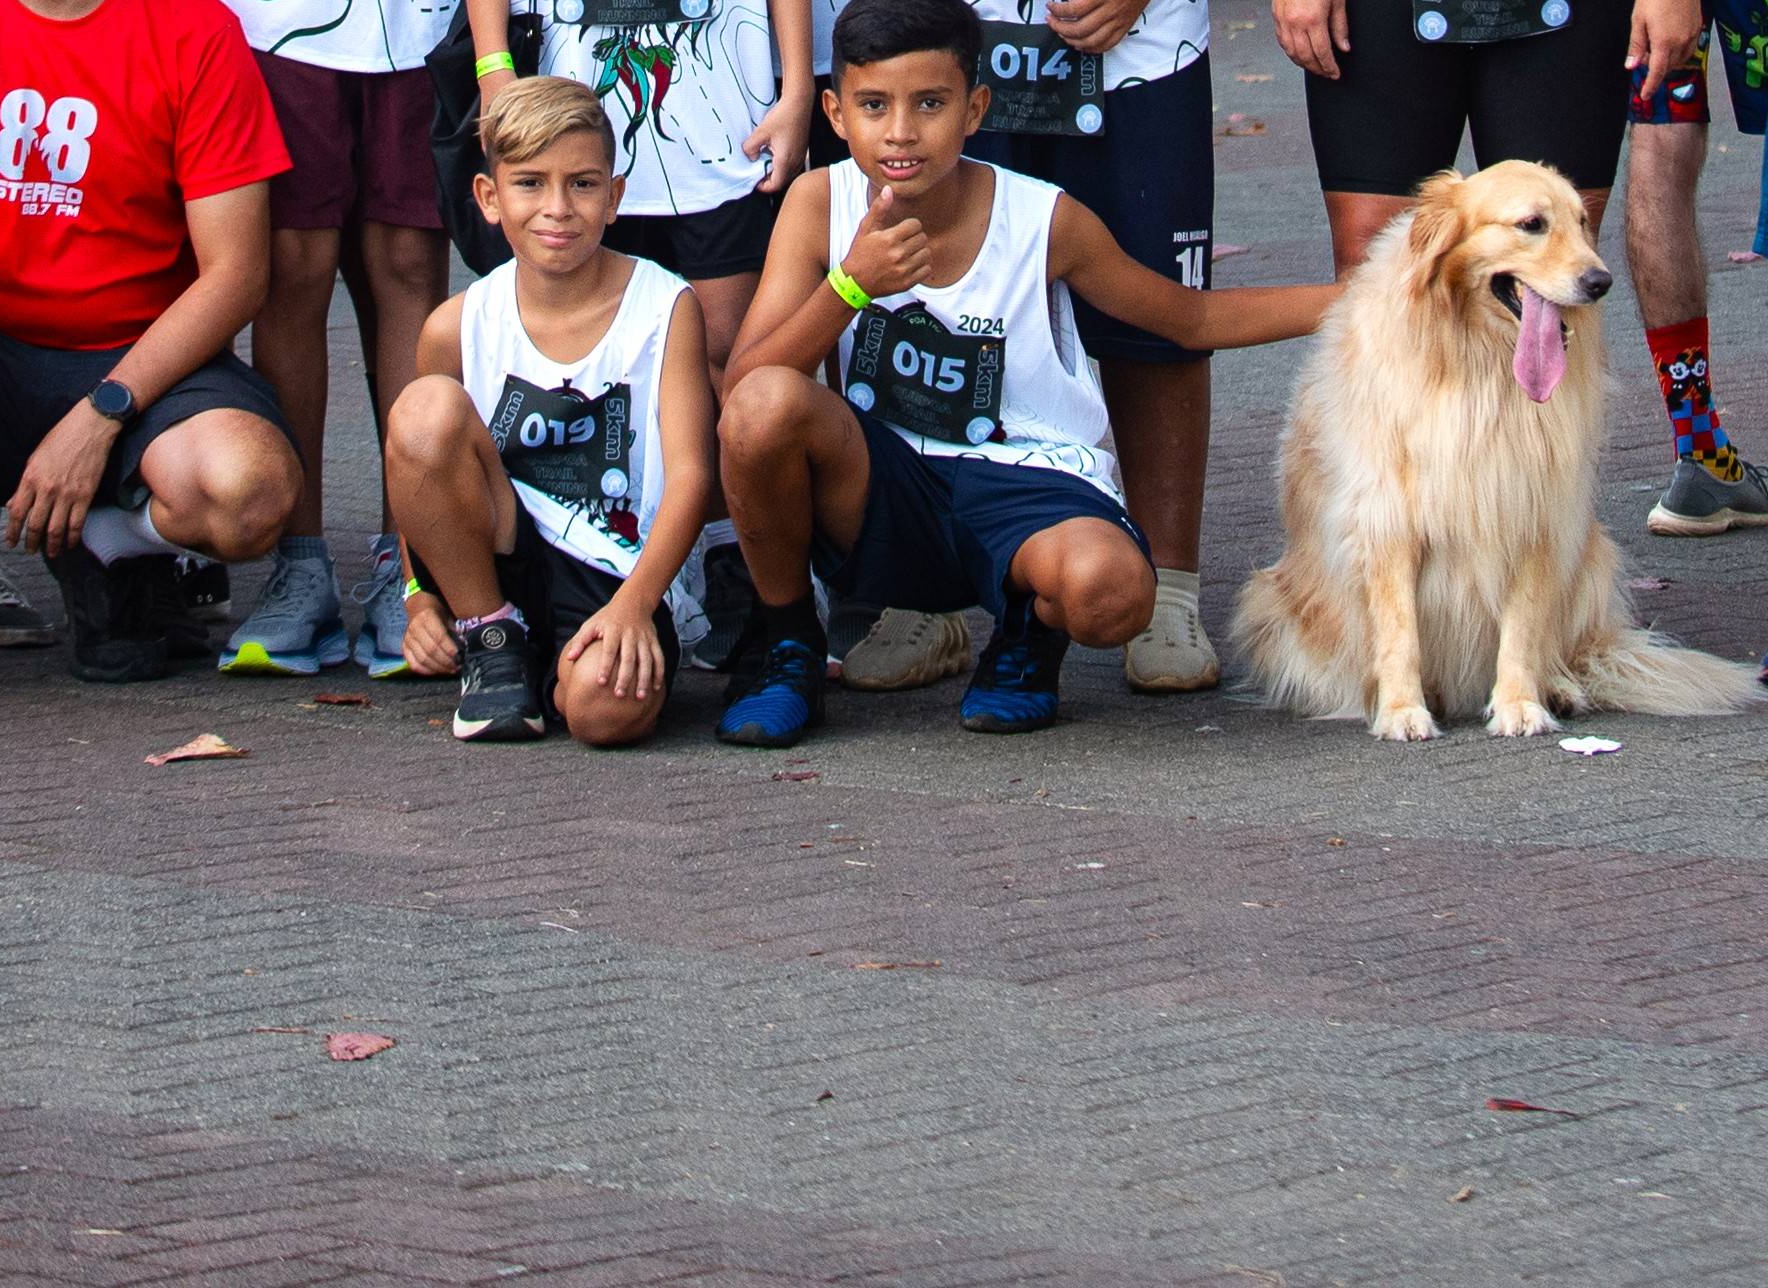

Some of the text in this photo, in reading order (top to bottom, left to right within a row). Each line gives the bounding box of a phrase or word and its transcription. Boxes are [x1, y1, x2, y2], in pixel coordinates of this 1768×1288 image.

[990, 42, 1073, 82] 014
[1079, 52, 1097, 97] km
[54, 204, 81, 218] FM
[1175, 245, 1205, 292] 14
[855, 316, 887, 379] 5km
[957, 313, 1006, 336] 2024
[892, 339, 967, 394] 015
[972, 348, 1000, 410] 5km
[519, 411, 597, 449] 019
[604, 397, 627, 461] 5km
